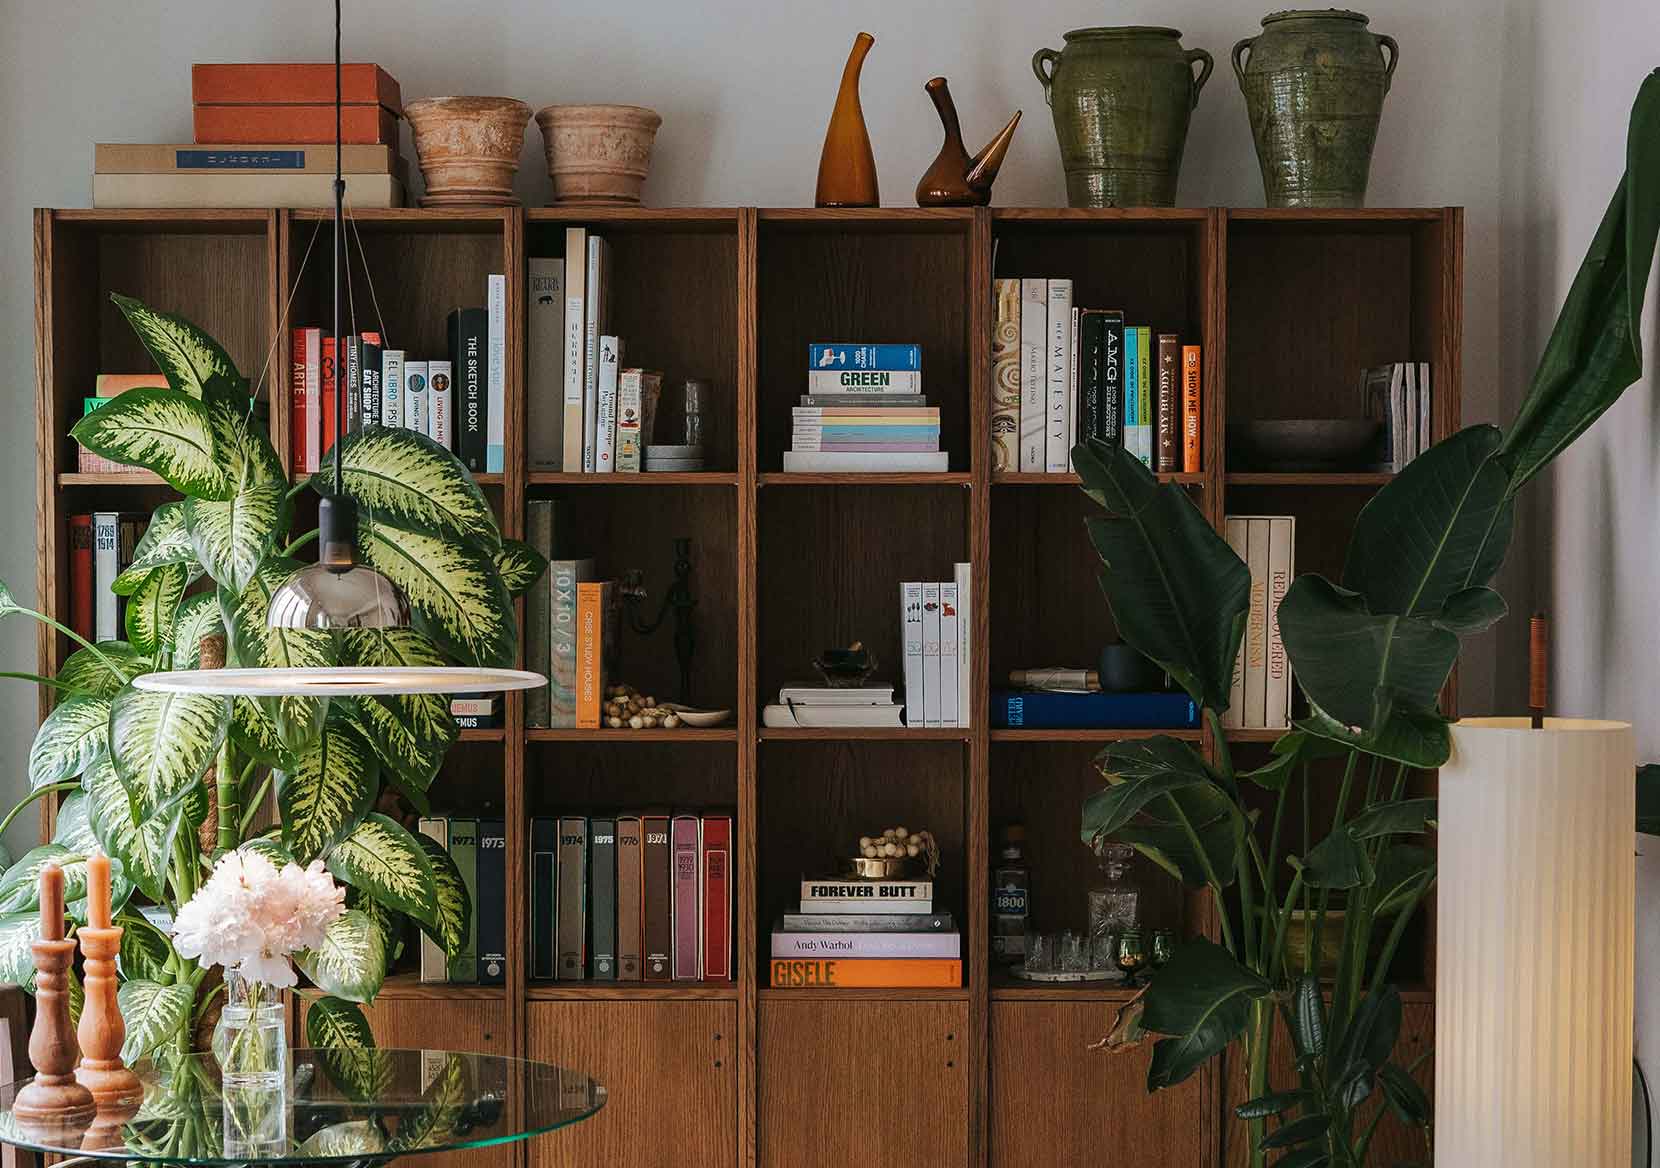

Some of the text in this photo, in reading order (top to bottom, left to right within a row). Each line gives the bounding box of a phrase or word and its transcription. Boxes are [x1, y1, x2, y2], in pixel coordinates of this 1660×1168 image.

[388, 360, 398, 370] EL
[1107, 330, 1117, 383] AMG
[293, 363, 305, 395] ARTE
[363, 369, 372, 385] EAT
[467, 336, 478, 432] THE SKETCH BOOK
[841, 372, 890, 386] GREEN
[388, 374, 398, 400] LIBRO
[1052, 345, 1063, 440] MAJESTY
[363, 387, 372, 410] SHOP
[1160, 368, 1169, 434] MY BUDDY
[1188, 370, 1197, 437] SHOW ME HOW
[436, 421, 443, 430] IN
[606, 392, 615, 446] Around Europe
[96, 525, 115, 537] 1789
[96, 538, 115, 550] 1914
[1250, 582, 1264, 668] MODERNISM
[584, 666, 592, 703] HOUSES
[561, 835, 583, 845] 1974
[594, 835, 614, 844] 1975
[647, 833, 667, 844] 1971
[811, 885, 916, 898] FOREVER BUTT
[997, 896, 1024, 908] 1800
[794, 941, 817, 952] Andy
[819, 941, 853, 950] Warhol
[774, 961, 836, 986] GISELE
